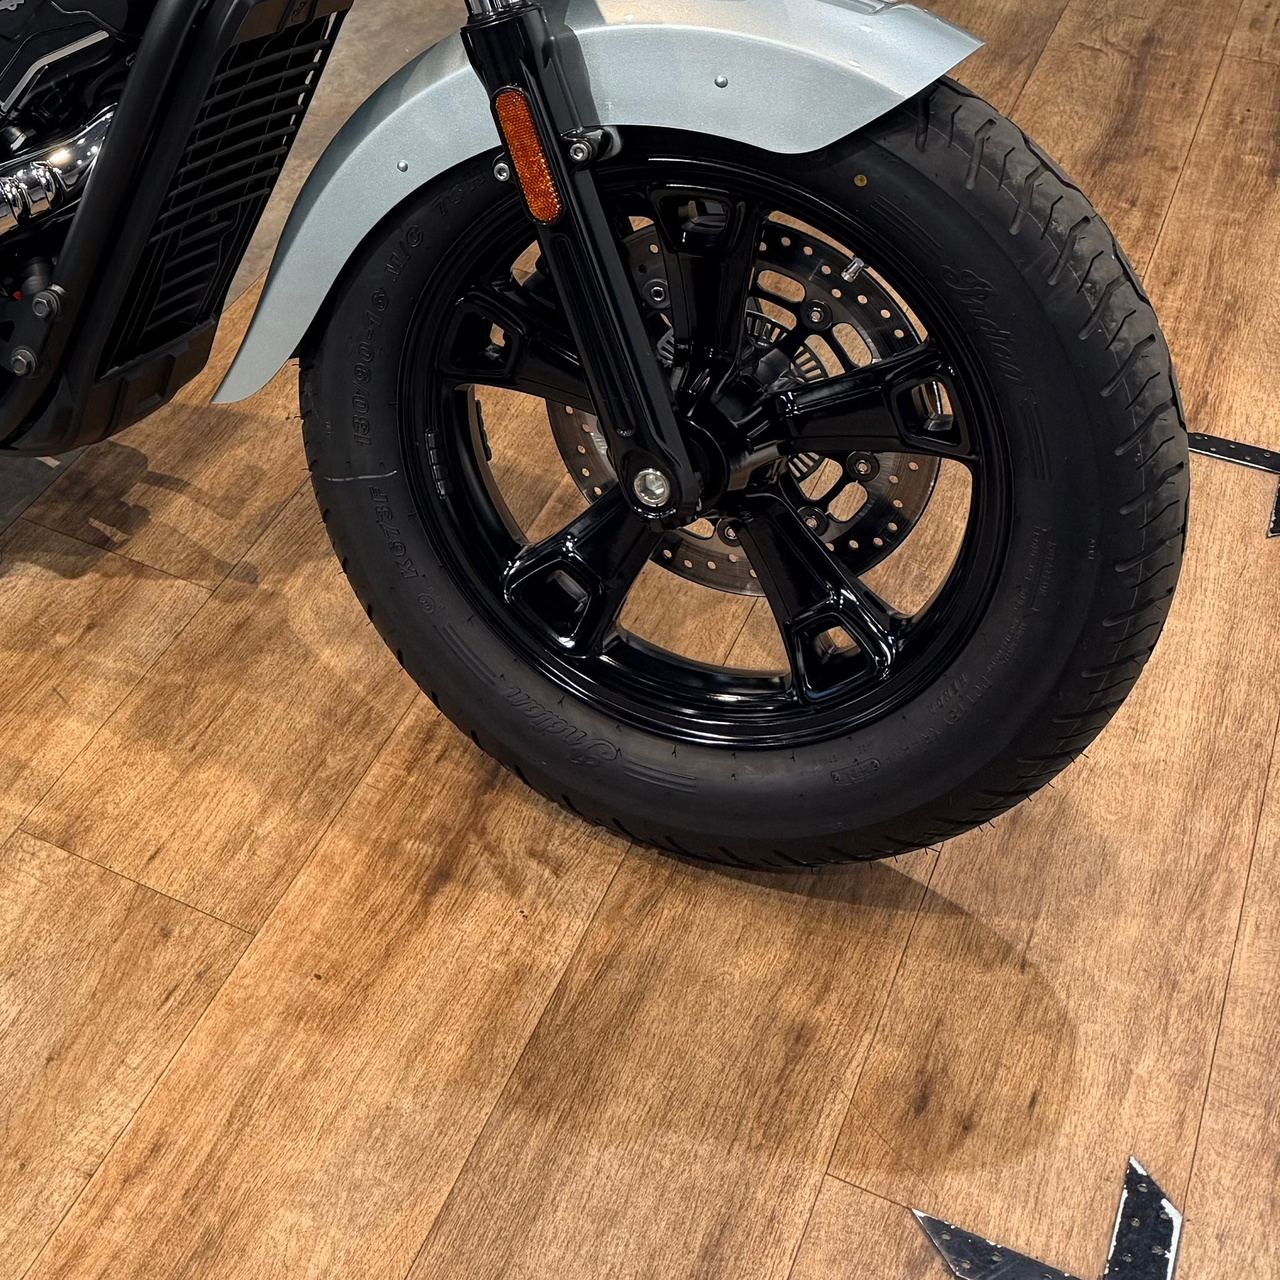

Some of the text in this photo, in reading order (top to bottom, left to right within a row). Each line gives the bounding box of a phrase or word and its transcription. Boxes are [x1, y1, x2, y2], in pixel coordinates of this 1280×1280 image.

[352, 286, 388, 447] 130/90-16
[384, 224, 424, 283] M/C
[939, 264, 1025, 387] Indian
[369, 485, 419, 580] K673F
[504, 685, 619, 769] Indian
